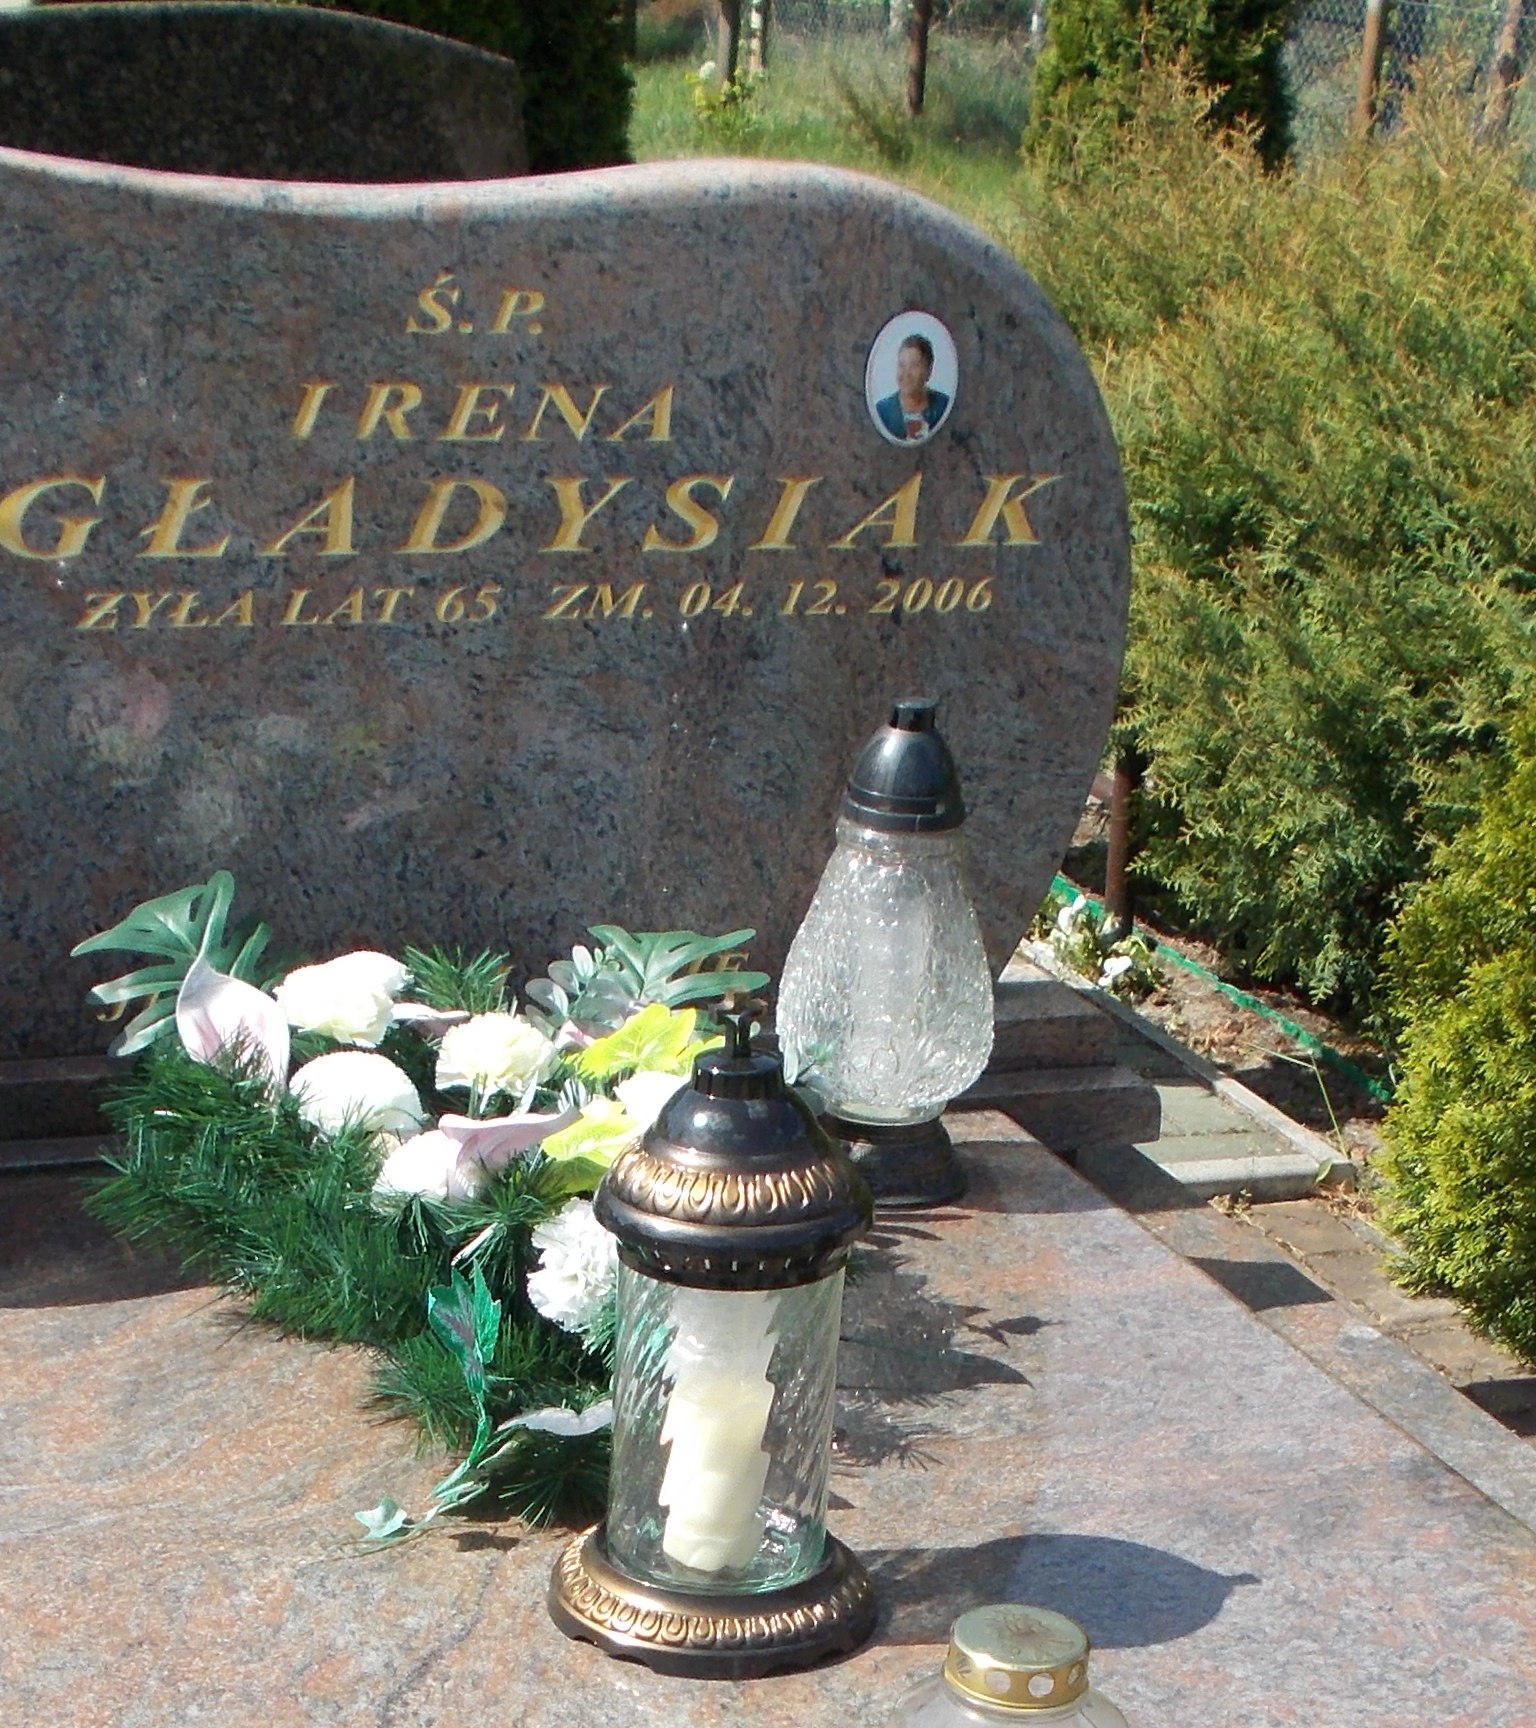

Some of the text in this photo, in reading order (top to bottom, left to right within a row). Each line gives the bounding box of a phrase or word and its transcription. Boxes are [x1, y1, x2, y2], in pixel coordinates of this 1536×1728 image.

[291, 380, 677, 442] IRENA
[279, 584, 415, 627] LAT
[434, 580, 503, 624] 65
[542, 580, 655, 620] ZM.
[677, 577, 755, 619] 04.
[780, 575, 848, 616] 12.
[867, 573, 996, 615] 2006
